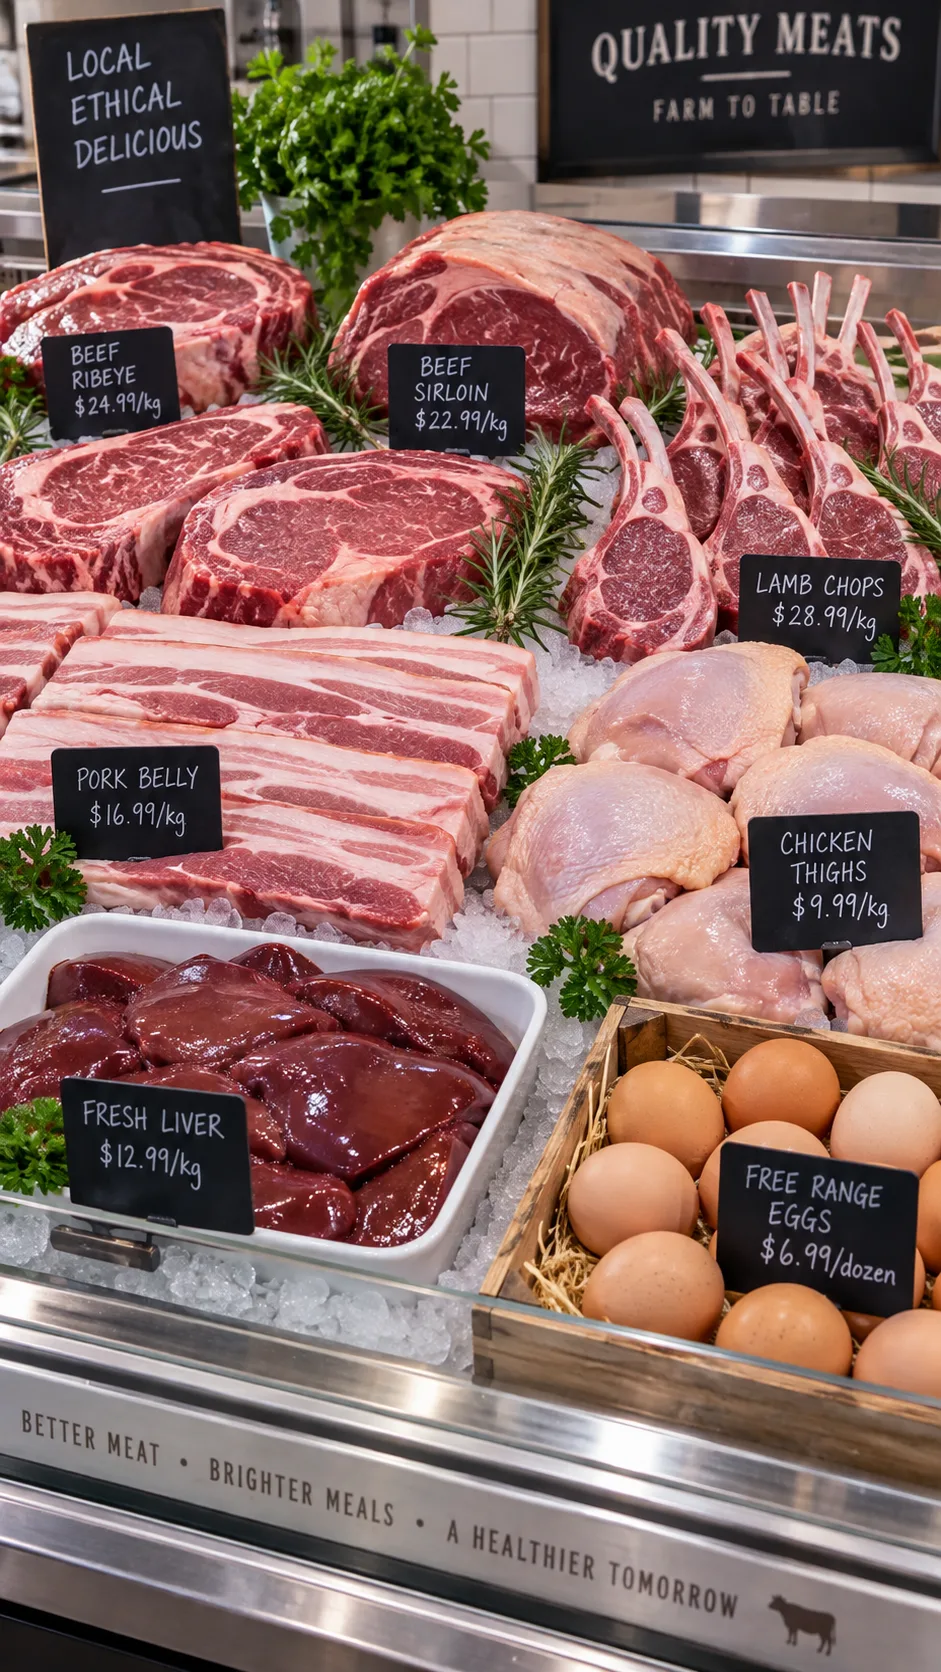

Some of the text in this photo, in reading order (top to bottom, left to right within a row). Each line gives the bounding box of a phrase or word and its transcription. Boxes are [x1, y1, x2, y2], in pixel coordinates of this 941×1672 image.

[67, 43, 151, 81] LOCAL
[592, 12, 902, 83] QUALITY MEATS
[72, 81, 181, 125] ETHICAL
[653, 91, 840, 122] FARM TO TABLE
[74, 120, 203, 169] DELICIOUS
[71, 342, 119, 365] BEEF
[421, 356, 471, 376] BEEF
[72, 365, 135, 389] RIBEYE
[415, 383, 488, 401] SIRLOIN
[75, 392, 160, 419] $24.99/kg
[415, 408, 507, 441] $22.99/kg
[757, 573, 884, 597] LAMB CHOPS
[773, 602, 875, 641] $28.99/kg
[78, 766, 198, 791] PORK BELLY
[90, 801, 184, 837] $16.99/kg
[781, 829, 872, 854] CHICKEN
[791, 861, 866, 884] THIGHS
[793, 892, 887, 928] $9.99/kg
[84, 1100, 224, 1138] FRESH LIVER
[100, 1139, 201, 1190] $12.99/kg
[746, 1165, 883, 1208] FREE RANGE
[769, 1202, 831, 1233] EGGS
[760, 1233, 896, 1286] $6.99/dozen
[22, 1410, 738, 1619] BETTER MEAT BRIGHTER MEALS A HEALTHIER TOMORROW
